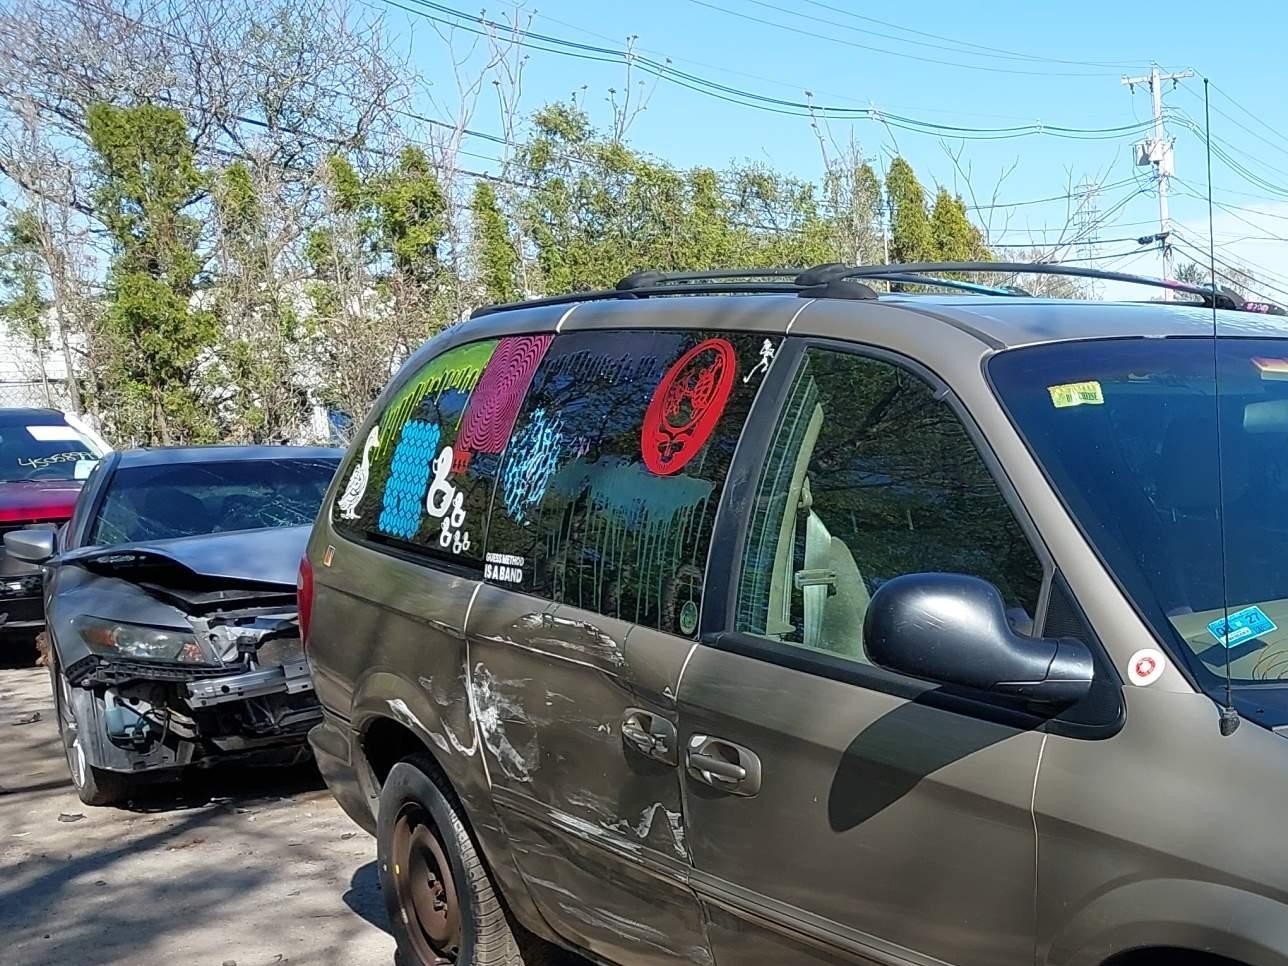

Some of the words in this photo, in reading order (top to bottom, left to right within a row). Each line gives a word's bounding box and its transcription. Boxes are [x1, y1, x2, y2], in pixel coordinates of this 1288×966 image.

[485, 552, 501, 563] GUESS
[484, 563, 492, 579] IS
[492, 565, 499, 580] A
[499, 566, 523, 583] BAND
